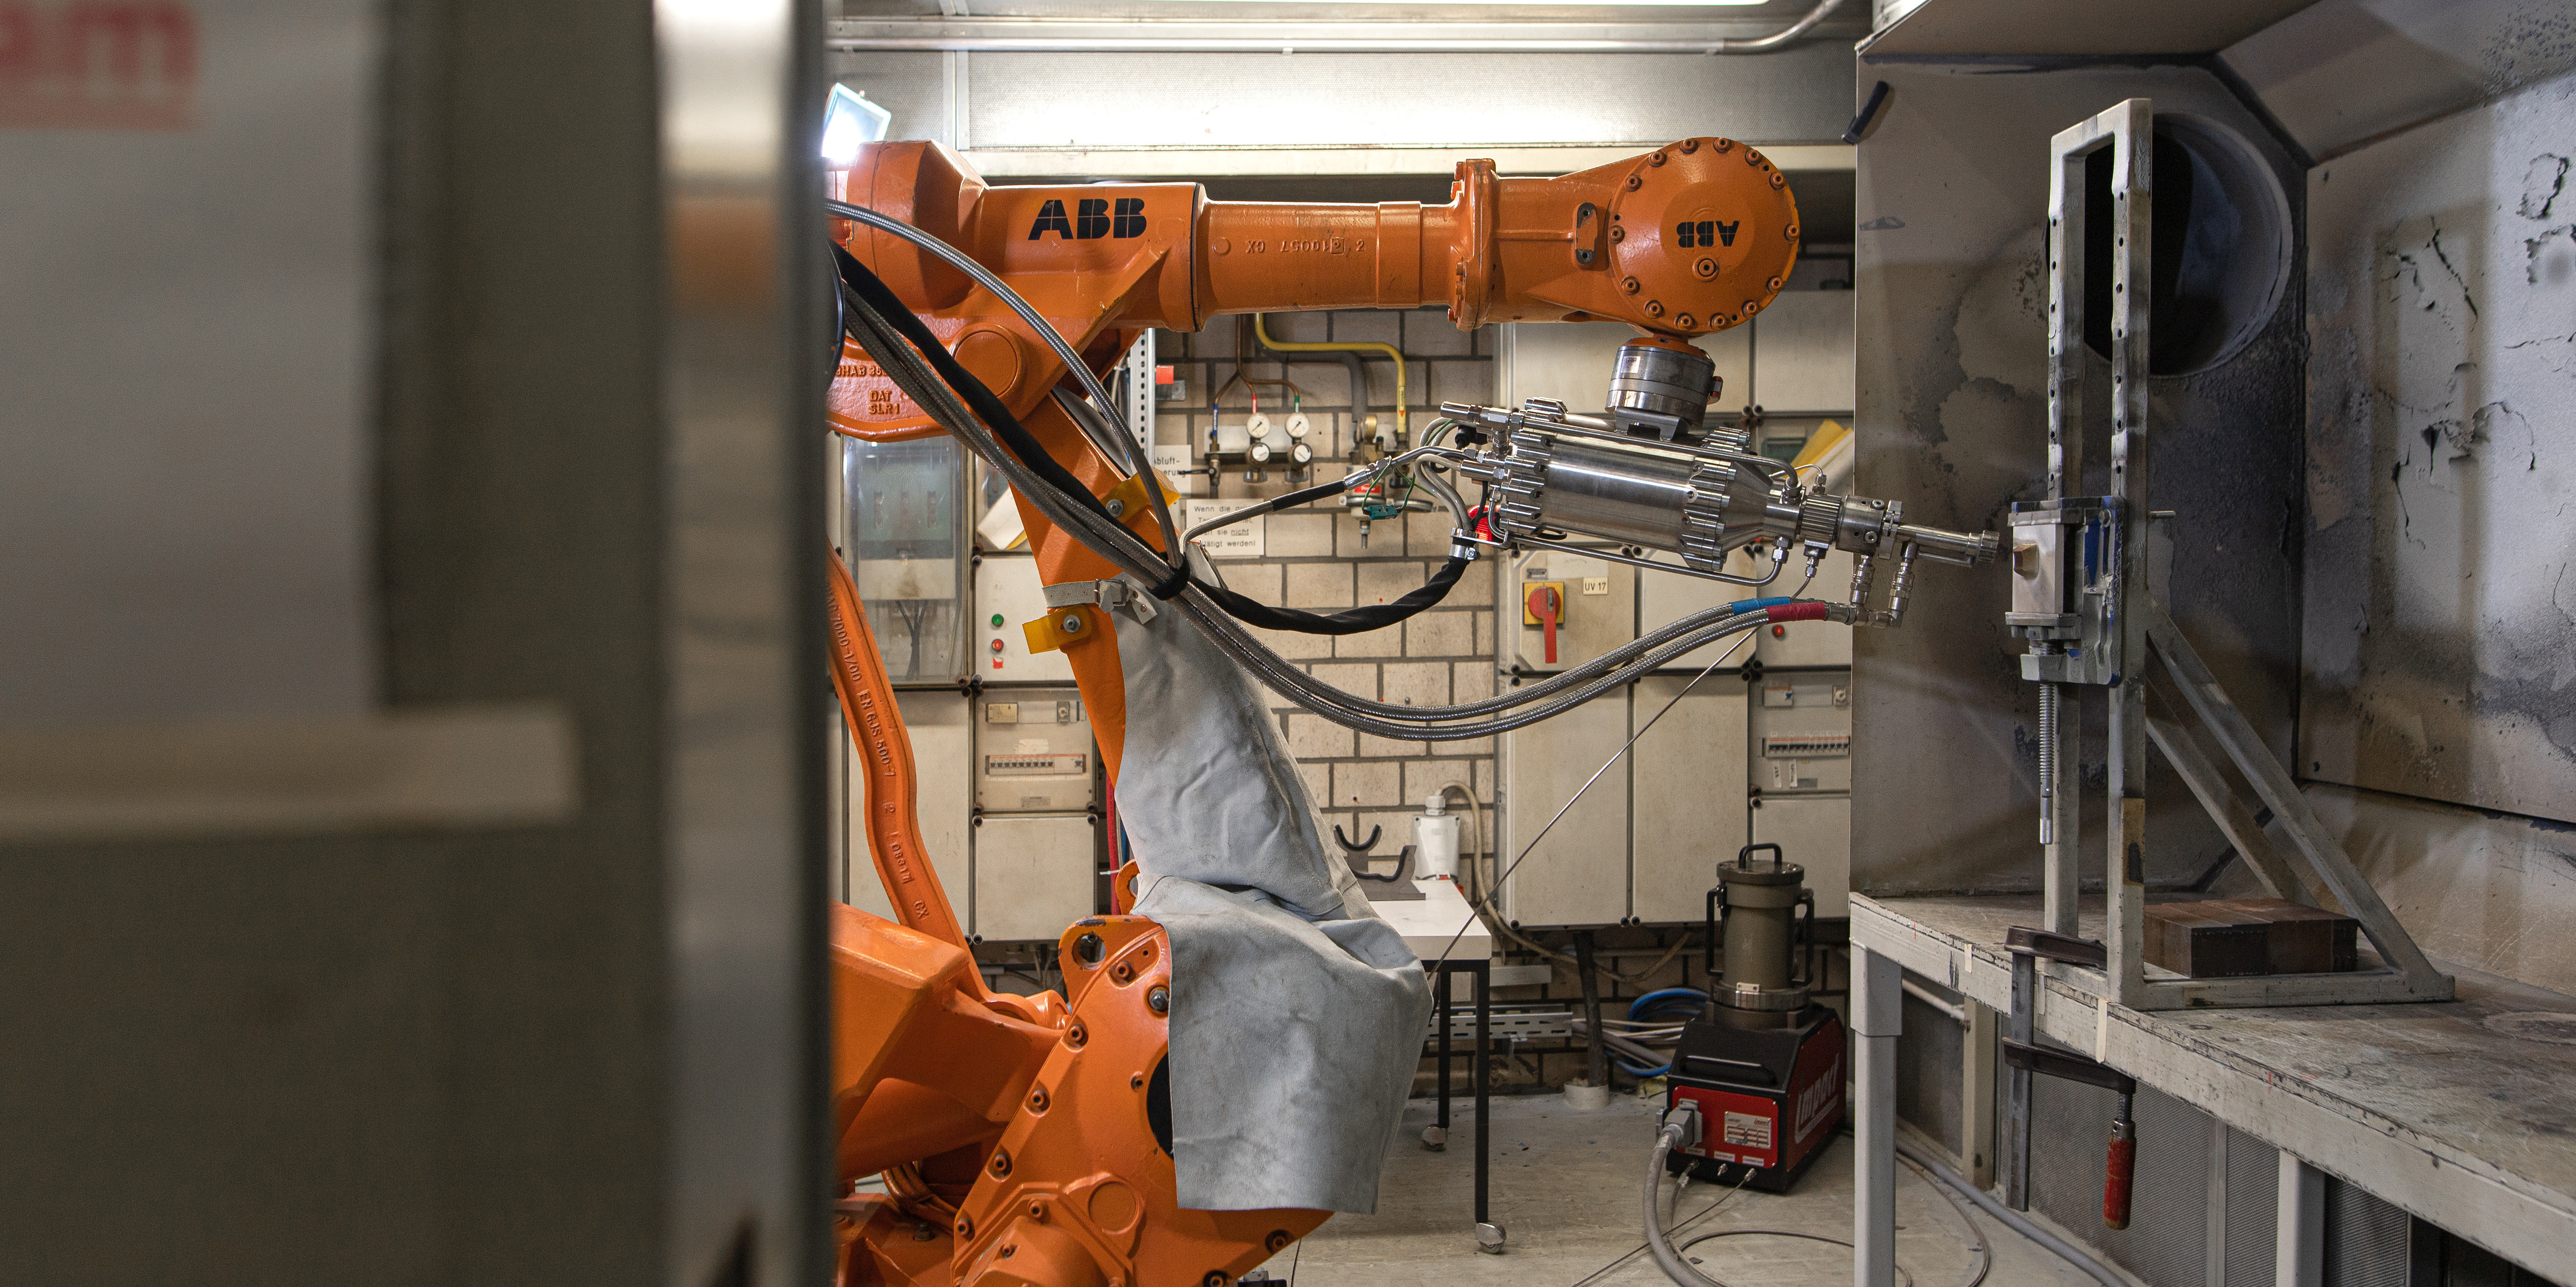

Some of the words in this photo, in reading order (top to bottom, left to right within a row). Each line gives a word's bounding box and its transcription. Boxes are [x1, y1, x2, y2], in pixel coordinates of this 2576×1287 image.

[1027, 197, 1147, 240] ABB
[1676, 220, 1740, 248] ABB
[869, 390, 892, 402] DAT
[1585, 582, 1595, 591] UV
